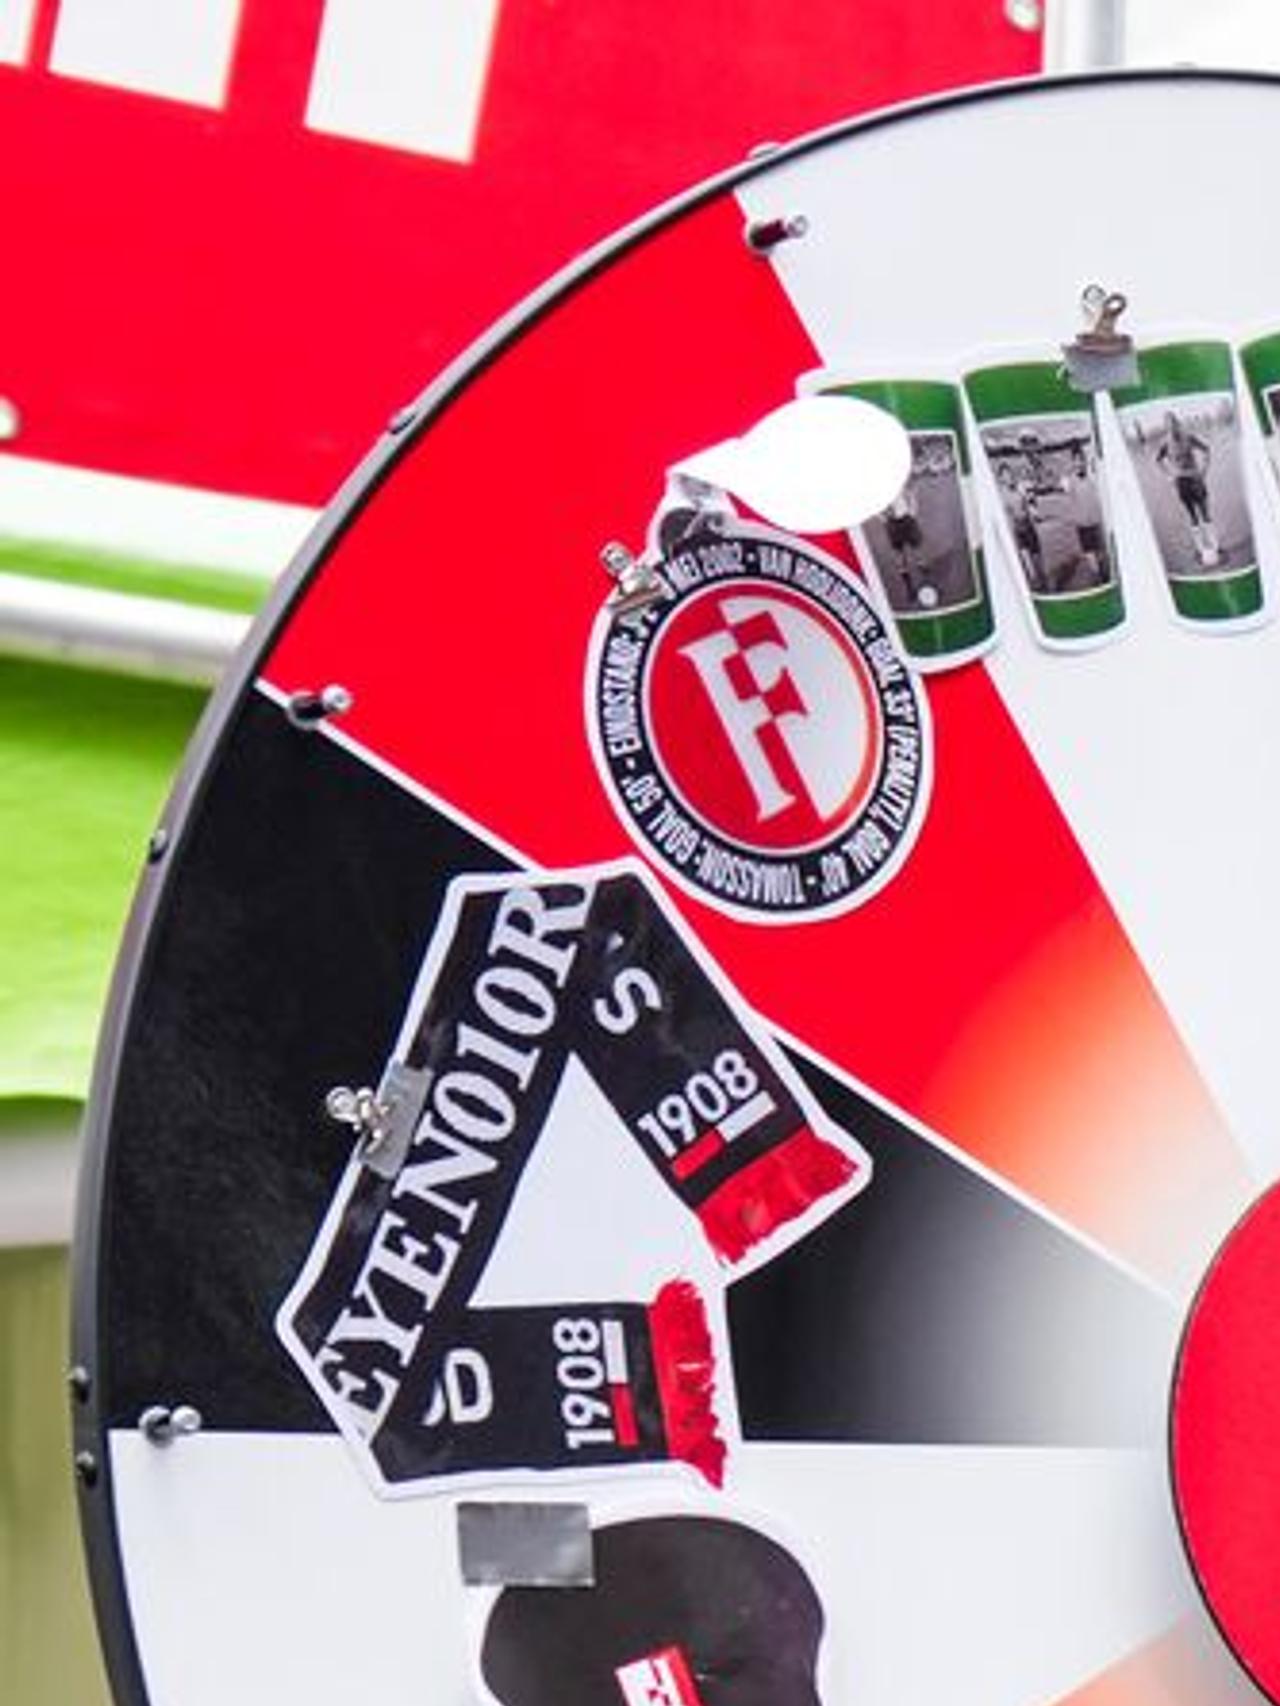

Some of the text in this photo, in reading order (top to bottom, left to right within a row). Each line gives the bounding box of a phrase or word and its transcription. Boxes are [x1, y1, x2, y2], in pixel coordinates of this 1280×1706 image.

[642, 801, 700, 868] GOAL
[692, 845, 807, 906] TOMASSON:
[638, 1051, 757, 1157] 1908
[554, 1318, 613, 1448] 1908
